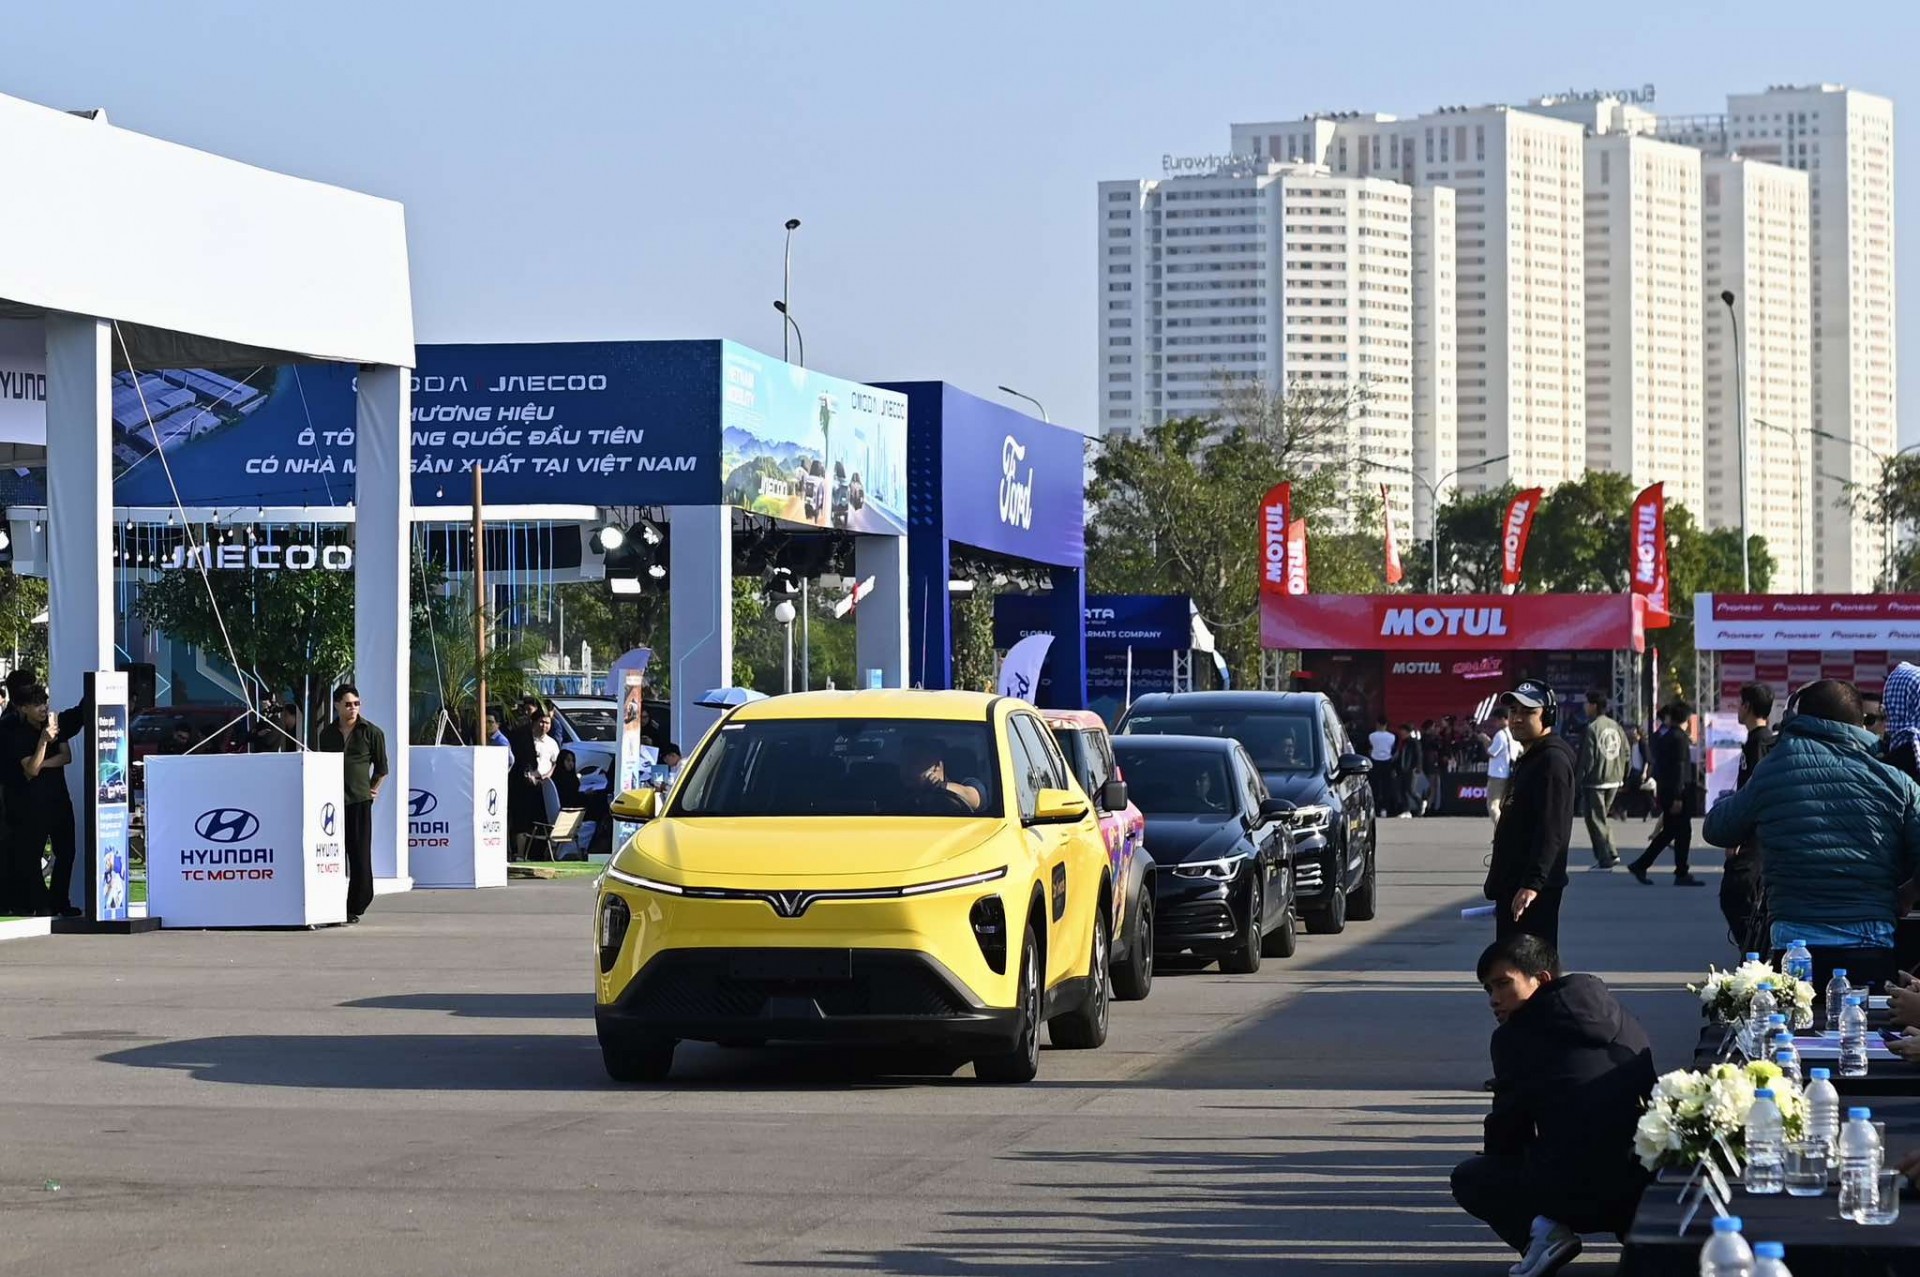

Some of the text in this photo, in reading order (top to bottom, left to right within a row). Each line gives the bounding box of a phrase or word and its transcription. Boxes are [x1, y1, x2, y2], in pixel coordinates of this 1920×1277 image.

[0, 371, 46, 401] YUND
[489, 375, 606, 391] JAECOO
[497, 402, 555, 424] HIỆU
[298, 427, 315, 446] Ô
[322, 427, 355, 446] TÔ
[452, 425, 523, 448] QUỐC
[528, 425, 581, 445] ĐẦU
[588, 426, 644, 444] TIÊN
[245, 455, 279, 473] CÓ
[284, 455, 336, 473] NHÀ
[458, 453, 525, 473] XUẤT
[531, 458, 569, 476] TẠI
[576, 453, 632, 476] VIỆT
[637, 456, 697, 472] NAM
[999, 435, 1033, 530] Ford
[1265, 502, 1284, 582] MOTUL
[1504, 500, 1530, 572] MOTUL
[1636, 503, 1656, 584] MOTUL
[161, 545, 352, 569] JAECOO
[1287, 538, 1305, 595] OTUL
[1380, 607, 1508, 636] MOTUL
[1118, 630, 1162, 639] COMPANY
[1392, 662, 1441, 674] MOTUL
[408, 838, 449, 847] OTOR
[181, 848, 273, 865] HYUNDAI
[181, 868, 274, 881] TC MOTOR
